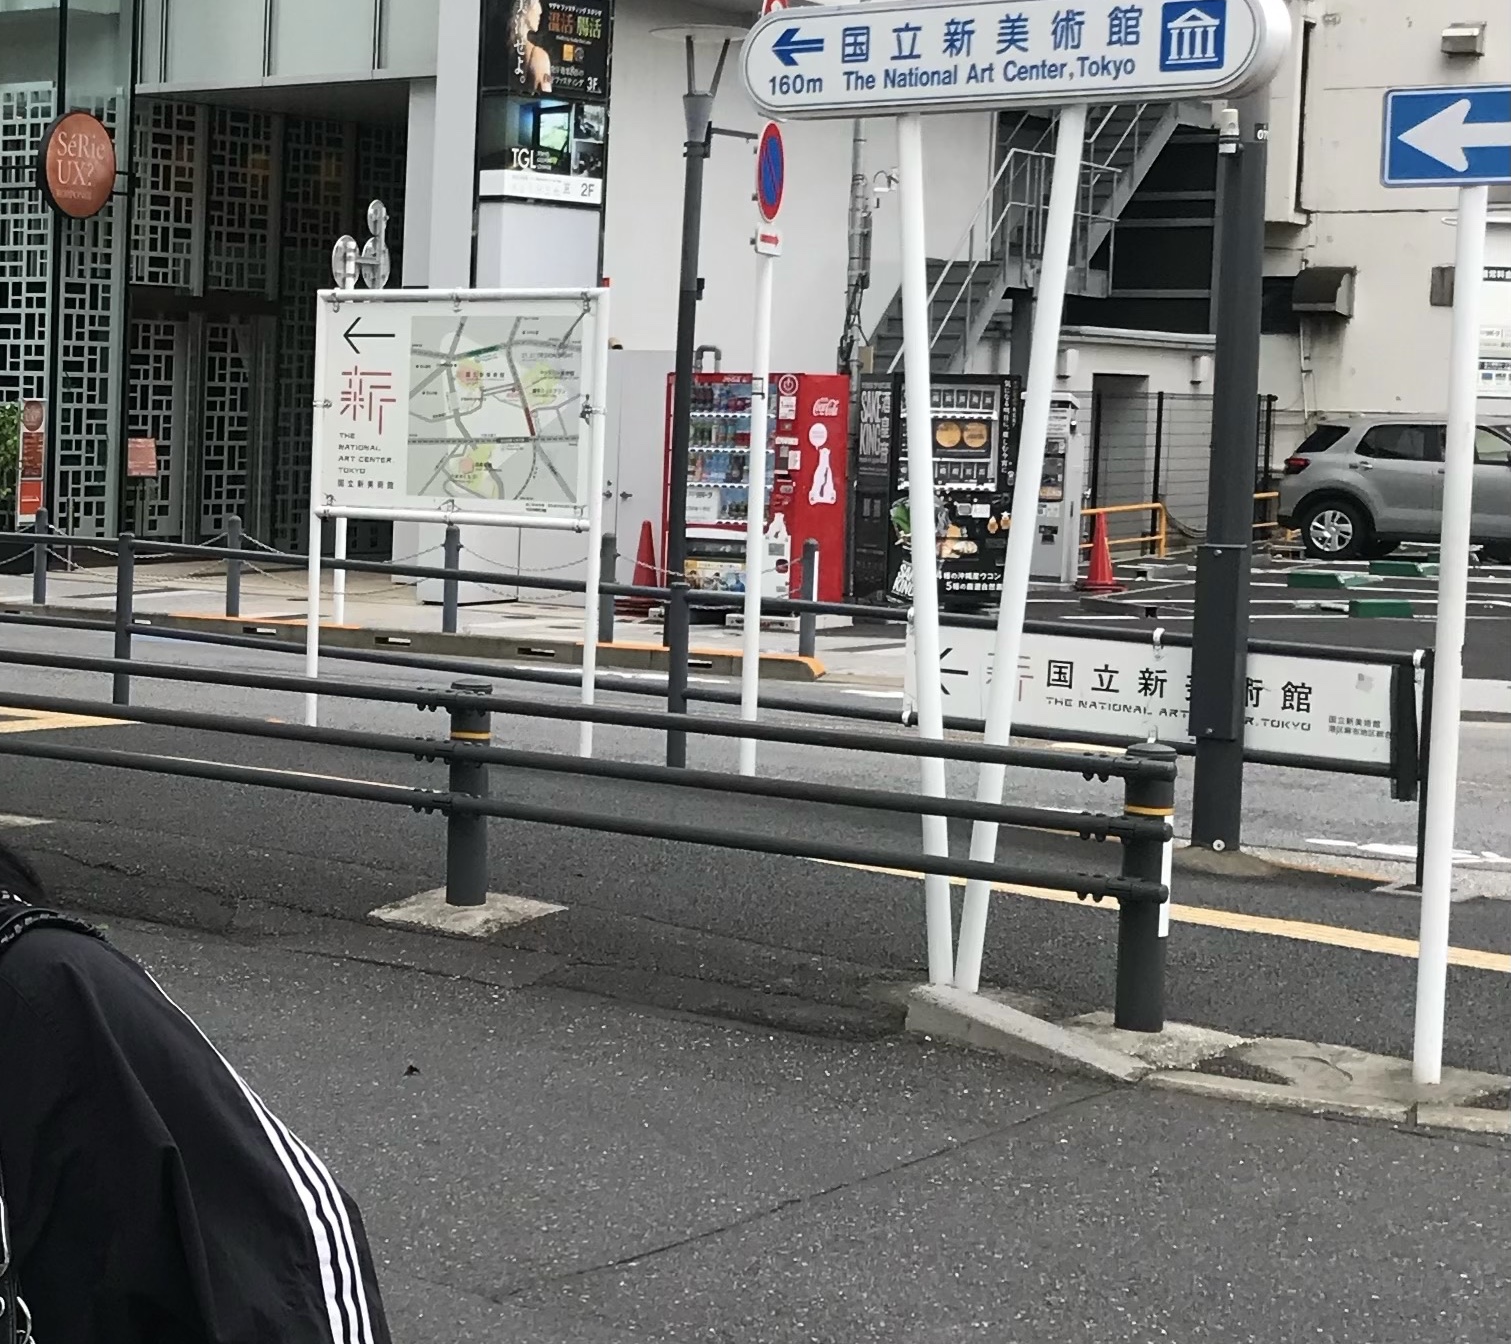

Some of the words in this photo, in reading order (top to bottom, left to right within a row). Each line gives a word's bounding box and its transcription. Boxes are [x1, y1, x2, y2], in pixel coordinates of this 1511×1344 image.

[841, 4, 1143, 65] 国立新美術館
[768, 73, 824, 97] 160m
[842, 69, 876, 92] The
[883, 63, 959, 90] National
[966, 61, 995, 85] Art
[511, 147, 537, 170] TGL
[56, 159, 94, 187] UX?
[580, 183, 596, 198] 2F
[339, 365, 397, 435] 新
[338, 444, 380, 452] NATIONAL
[338, 467, 366, 475] TOKYO
[1046, 696, 1073, 707] THE
[1078, 699, 1153, 716] NATIONAL
[1159, 707, 1189, 718] ART
